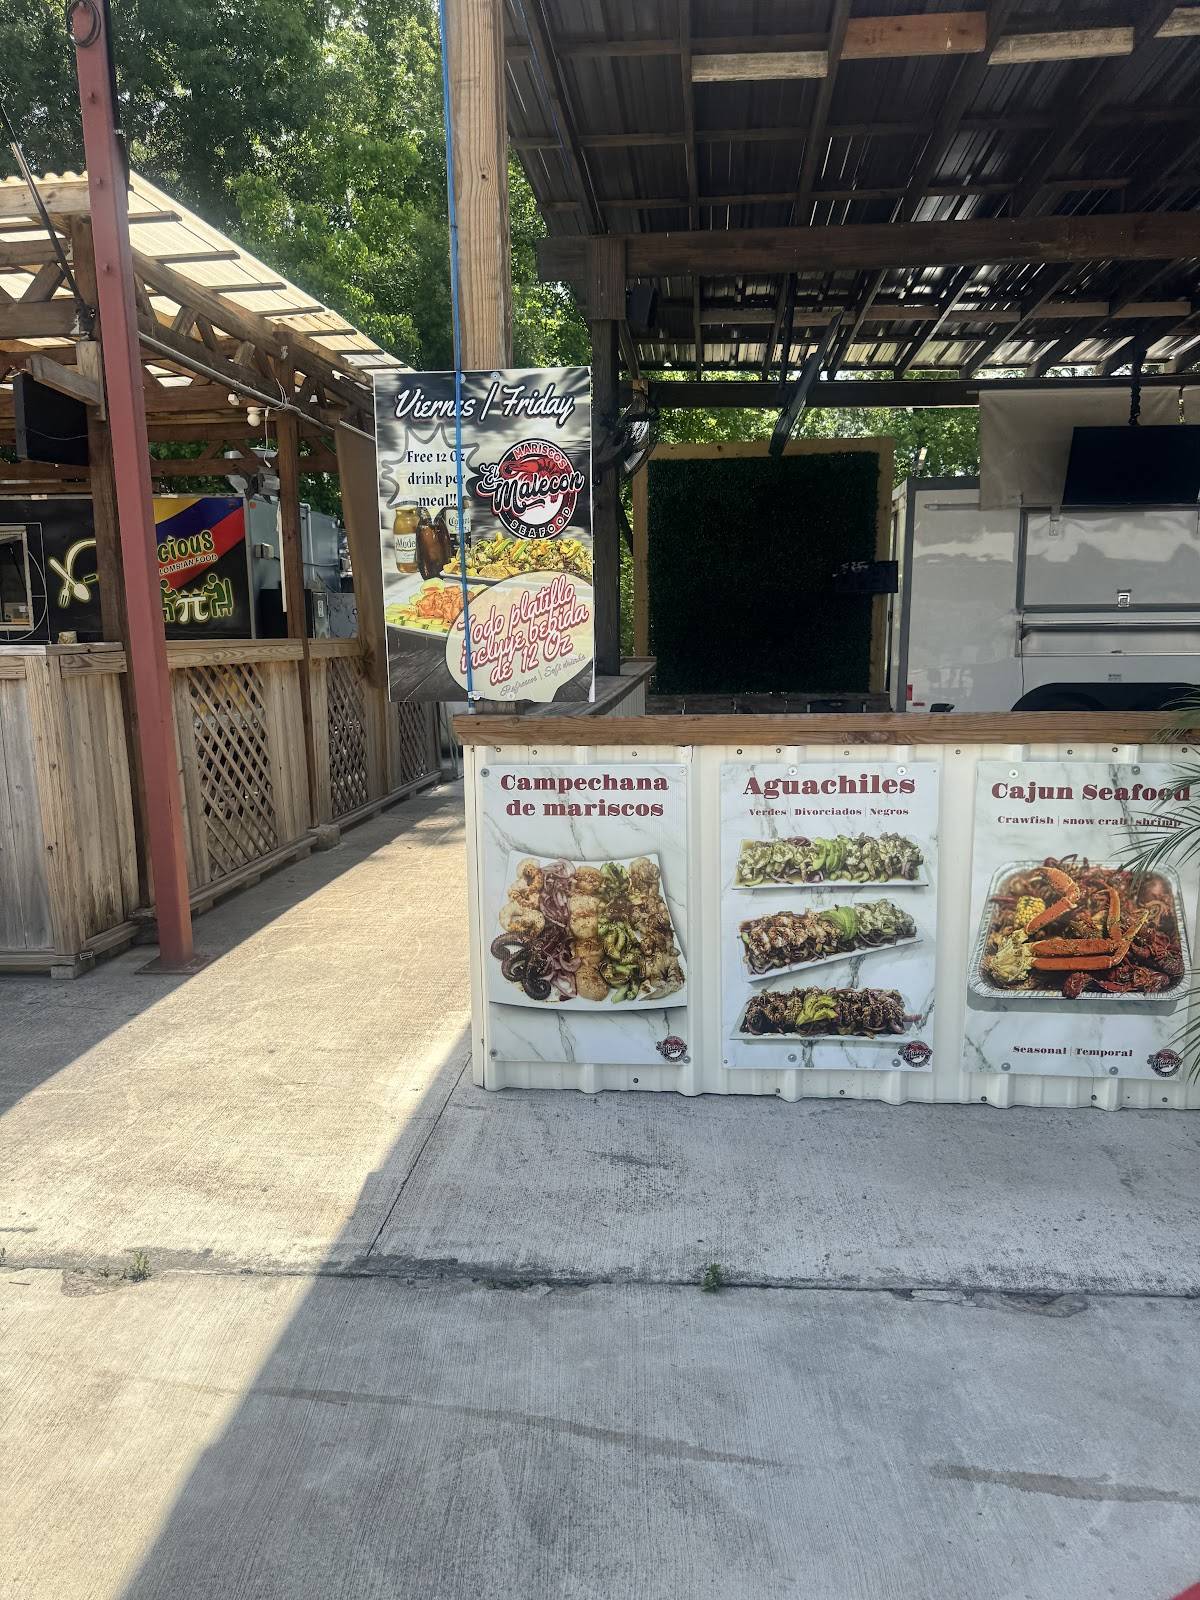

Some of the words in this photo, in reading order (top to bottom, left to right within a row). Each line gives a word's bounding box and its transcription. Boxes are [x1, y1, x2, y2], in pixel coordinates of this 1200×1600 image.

[395, 388, 476, 418] Viernes
[502, 383, 576, 427] Friday
[406, 450, 433, 463] Free
[436, 453, 448, 462] 12
[513, 444, 567, 471] MARISCOS
[407, 471, 442, 485] drink
[476, 463, 500, 494] El
[492, 471, 585, 514] Malecon
[509, 506, 572, 538] SEAFOOD
[157, 528, 215, 564] cious
[158, 558, 194, 576] LOMBIAN
[195, 553, 219, 565] FOOD
[457, 604, 505, 645] Todo
[508, 573, 576, 638] platillo
[528, 596, 590, 644] bebida
[489, 657, 514, 686] de
[520, 642, 540, 673] 12
[542, 631, 574, 663] Oz
[500, 774, 669, 794] Campechana
[742, 775, 916, 801] Aguachiles
[991, 781, 1074, 803] Cajun
[1082, 782, 1191, 802] Seafood
[506, 799, 536, 816] de
[542, 799, 665, 817] mariscos
[748, 807, 787, 817] Verdes
[794, 806, 862, 816] Divorciados
[869, 807, 910, 818] Negros
[997, 815, 1055, 826] Crawfish
[1063, 817, 1096, 826] snow
[1012, 1045, 1067, 1056] Seasonal
[1075, 1047, 1134, 1058] Temporal
